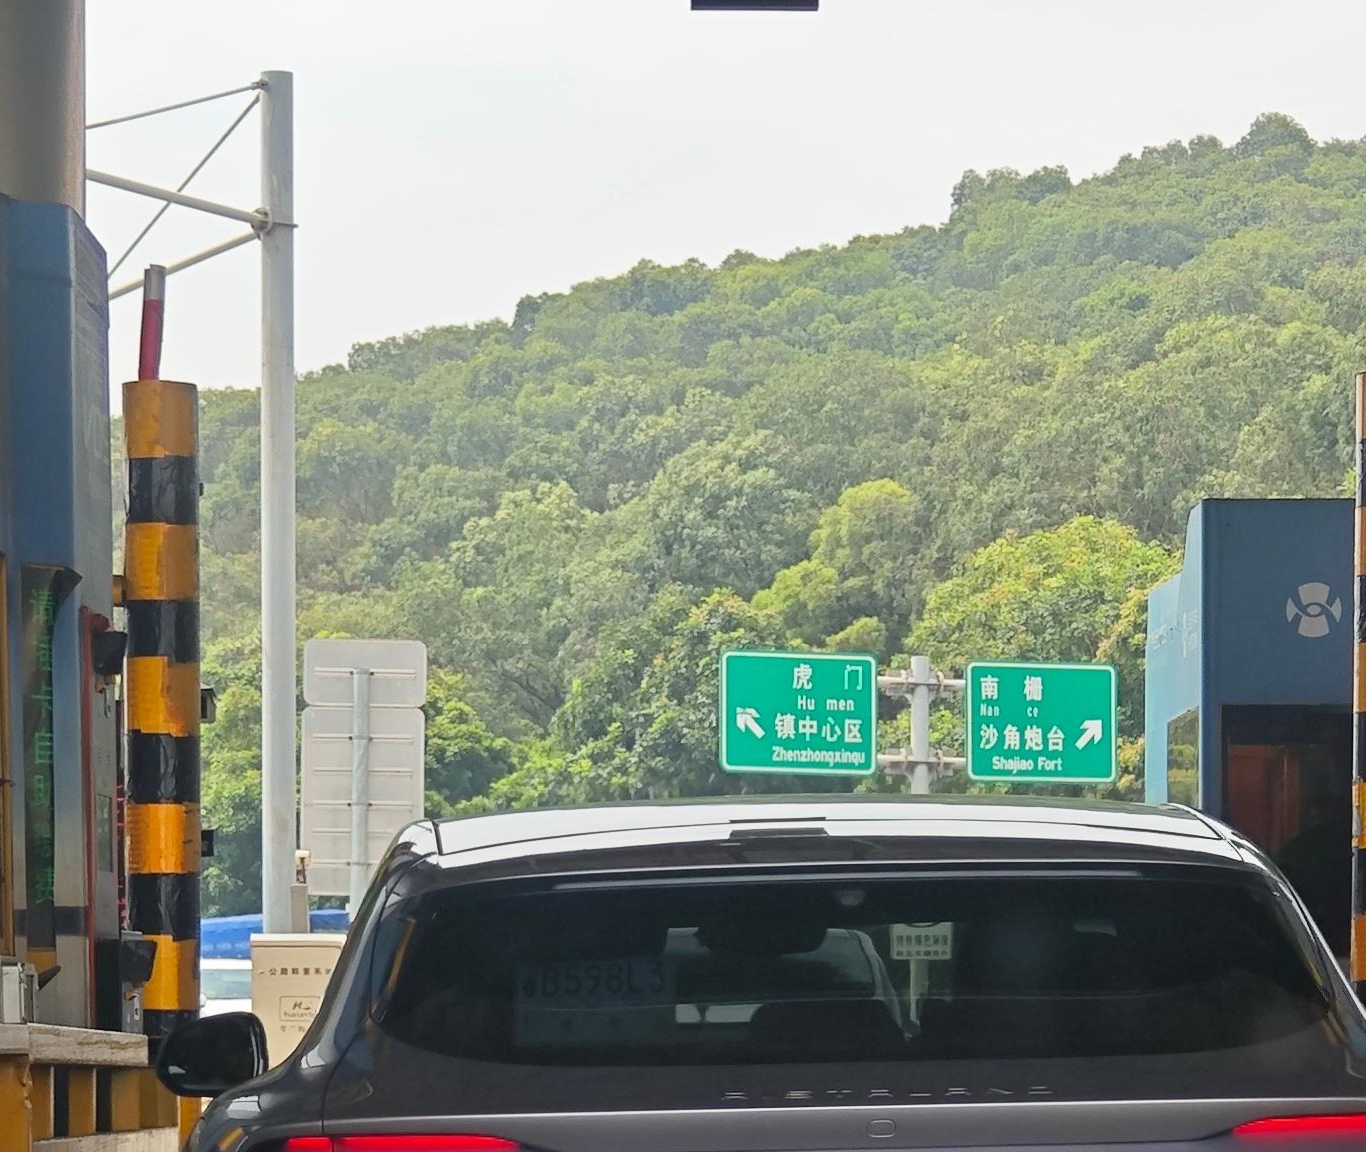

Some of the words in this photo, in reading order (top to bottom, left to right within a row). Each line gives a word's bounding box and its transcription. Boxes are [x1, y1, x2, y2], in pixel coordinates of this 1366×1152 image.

[792, 663, 863, 690] 虎门
[797, 695, 815, 711] Hu
[826, 698, 855, 711] men
[775, 712, 863, 743] 镇中心区
[980, 724, 1065, 751] 沙角炮台
[772, 746, 866, 767] Zhenzhongxinqu
[992, 756, 1034, 774] Shajiao
[1037, 756, 1063, 771] Fort
